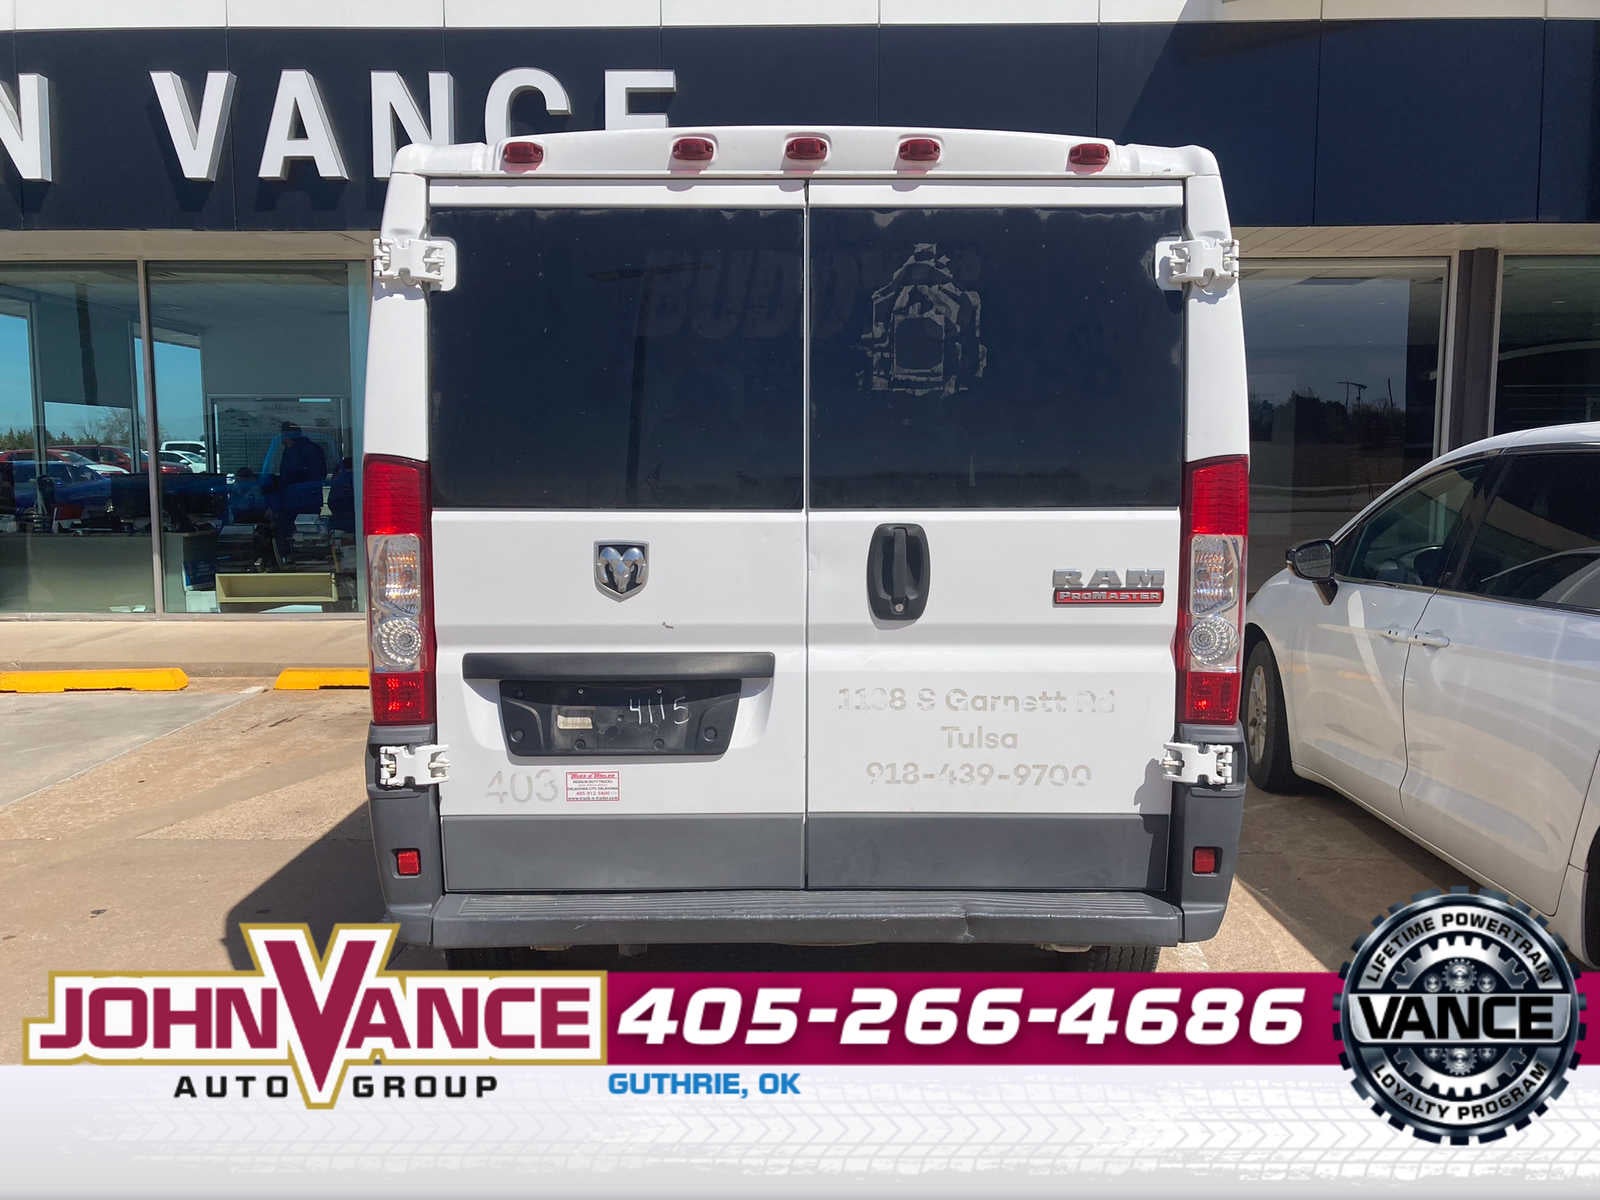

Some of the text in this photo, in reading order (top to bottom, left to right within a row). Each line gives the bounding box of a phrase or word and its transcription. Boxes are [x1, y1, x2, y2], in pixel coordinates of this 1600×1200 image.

[149, 67, 677, 181] VANCE
[1052, 569, 1165, 588] RAM
[629, 695, 690, 725] 4115
[917, 688, 936, 711] S
[945, 688, 1067, 712] Garnett
[941, 725, 1019, 750] Tulsa
[486, 769, 558, 803] 403
[866, 762, 1092, 787] 918-439-9700
